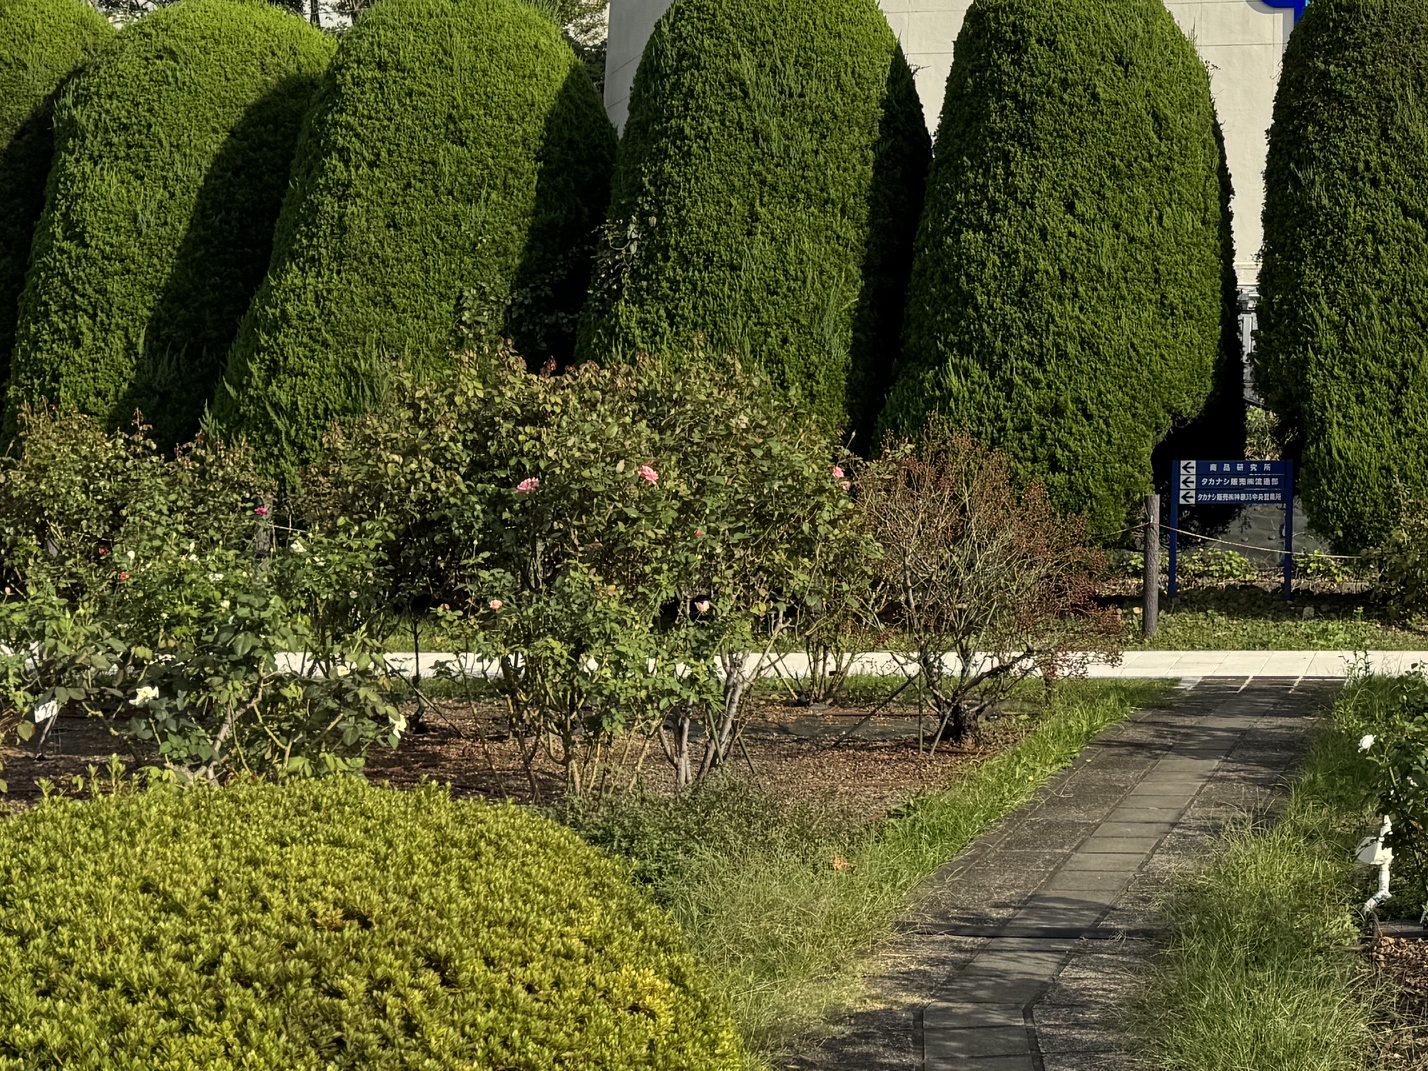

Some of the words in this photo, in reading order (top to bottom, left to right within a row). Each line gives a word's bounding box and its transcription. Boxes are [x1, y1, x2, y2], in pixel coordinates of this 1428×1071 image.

[1209, 463, 1272, 472] 商品研究所
